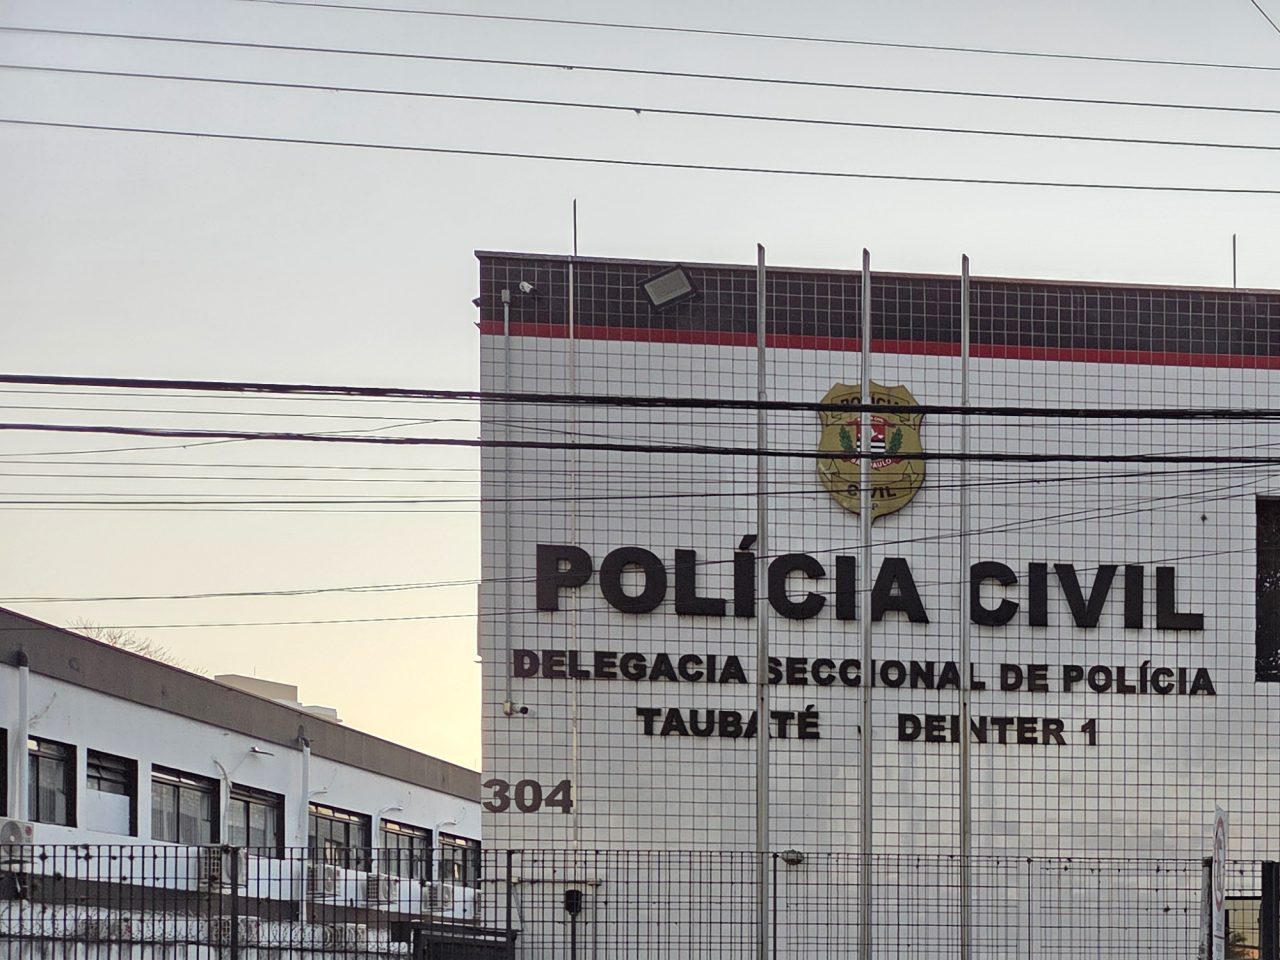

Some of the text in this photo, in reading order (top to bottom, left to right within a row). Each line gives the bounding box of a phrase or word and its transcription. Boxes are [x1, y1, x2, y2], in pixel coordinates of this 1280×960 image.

[536, 534, 1204, 630] POLÍCIA CIVIL
[513, 649, 1217, 695] DELEGACIA SECCIONAL DE POLÍCIA
[636, 704, 1097, 746] TAUBATÉ DEINTER 1
[482, 778, 574, 814] 304
